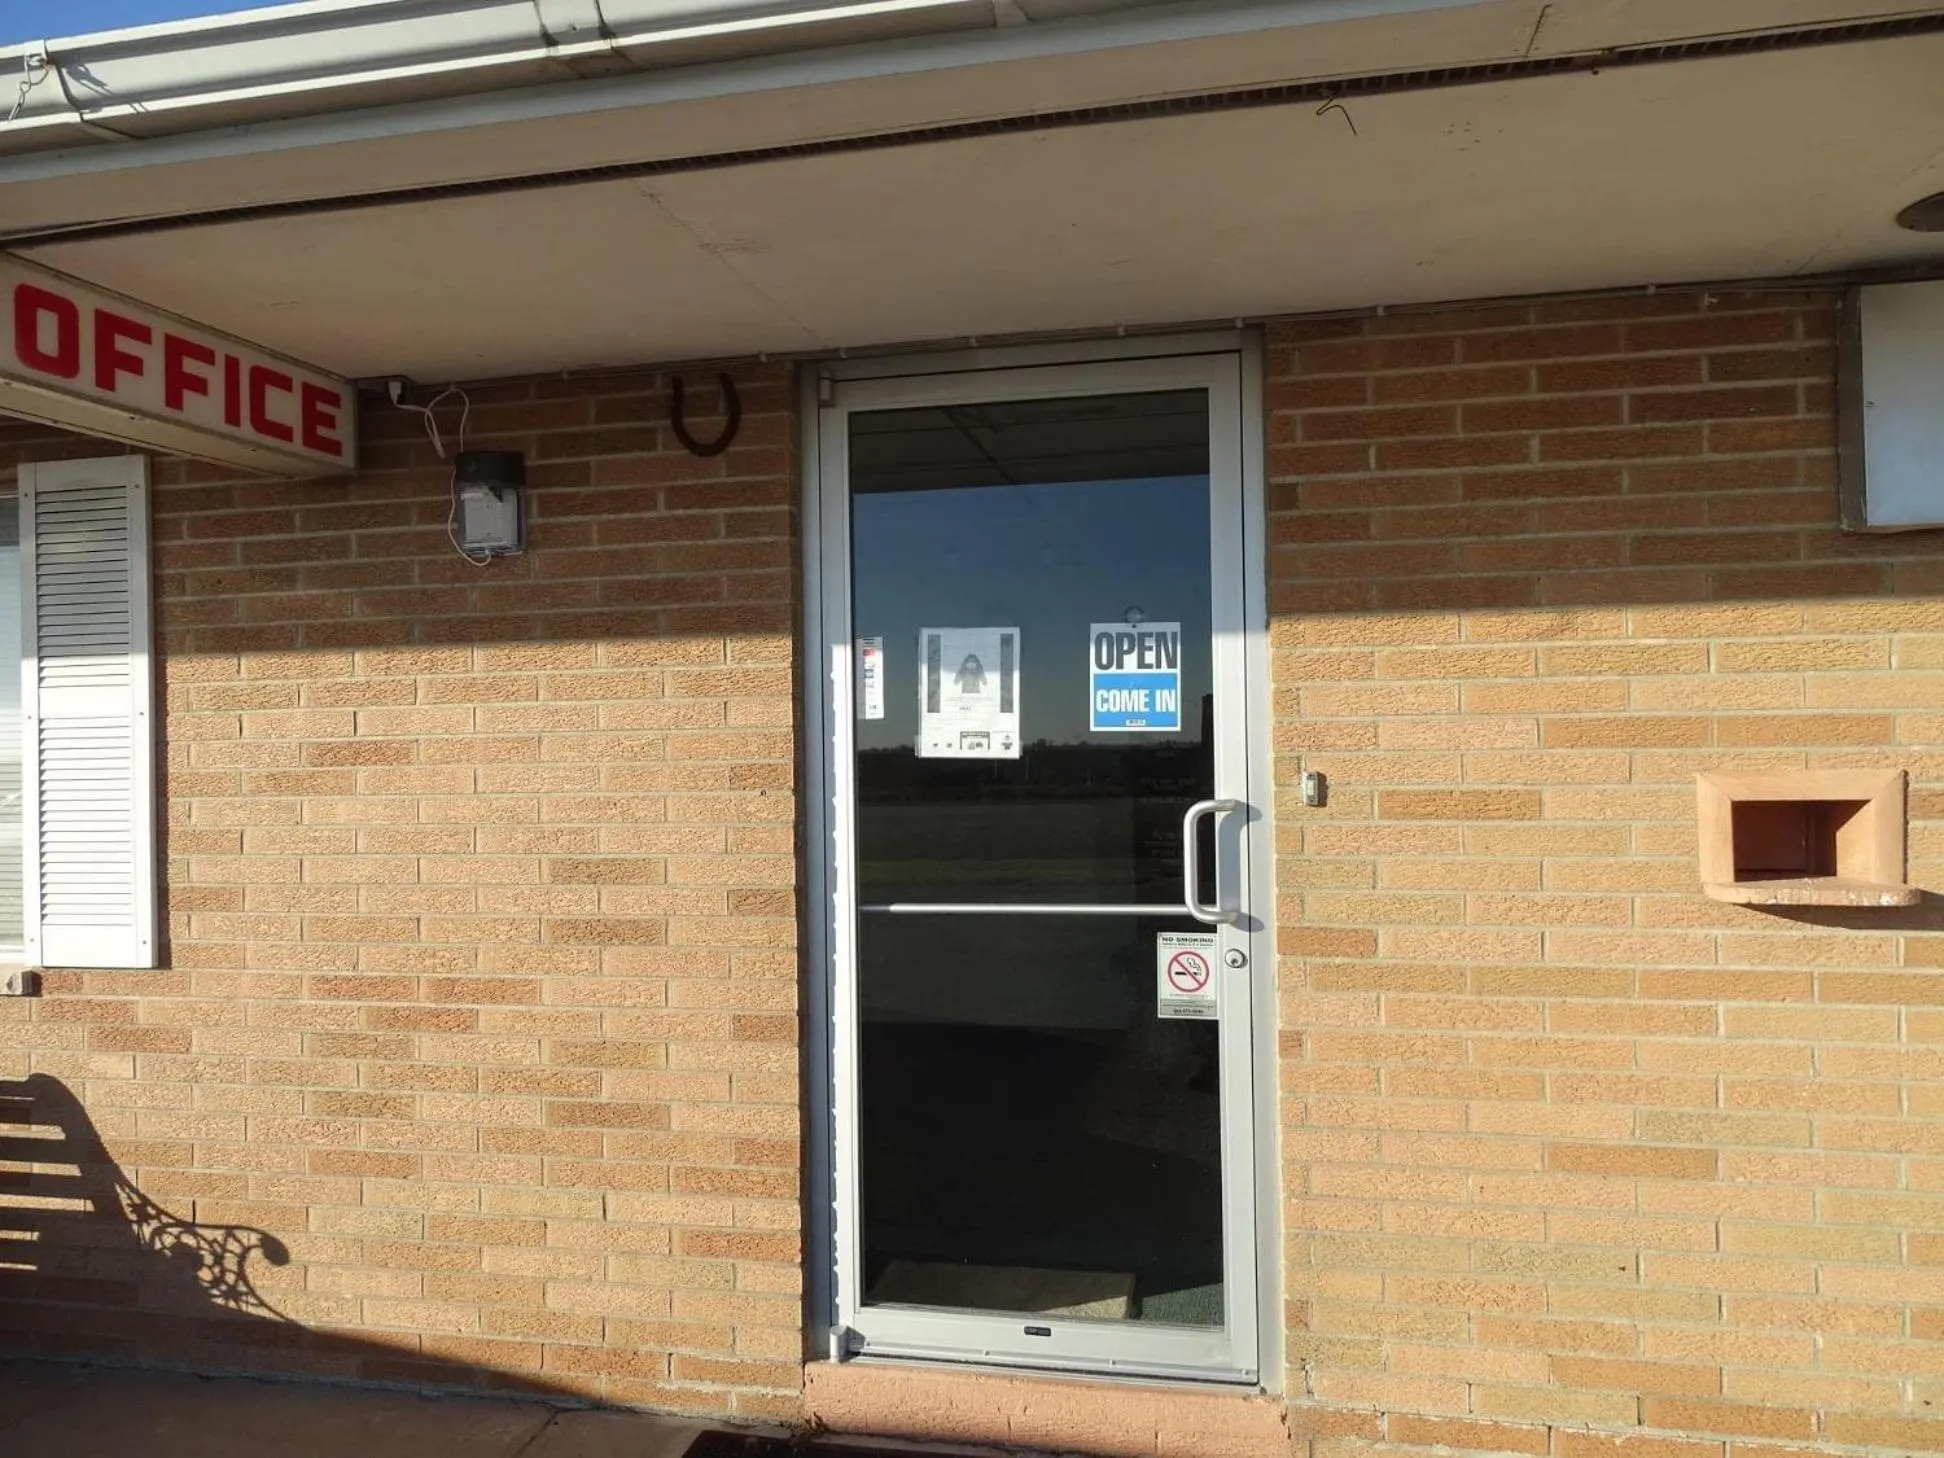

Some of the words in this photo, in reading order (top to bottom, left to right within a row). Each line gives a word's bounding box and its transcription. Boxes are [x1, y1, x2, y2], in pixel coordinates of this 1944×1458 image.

[14, 283, 342, 456] OFFICE
[1094, 631, 1178, 670] OPEN
[1096, 688, 1150, 713] COME
[1155, 688, 1176, 713] IN
